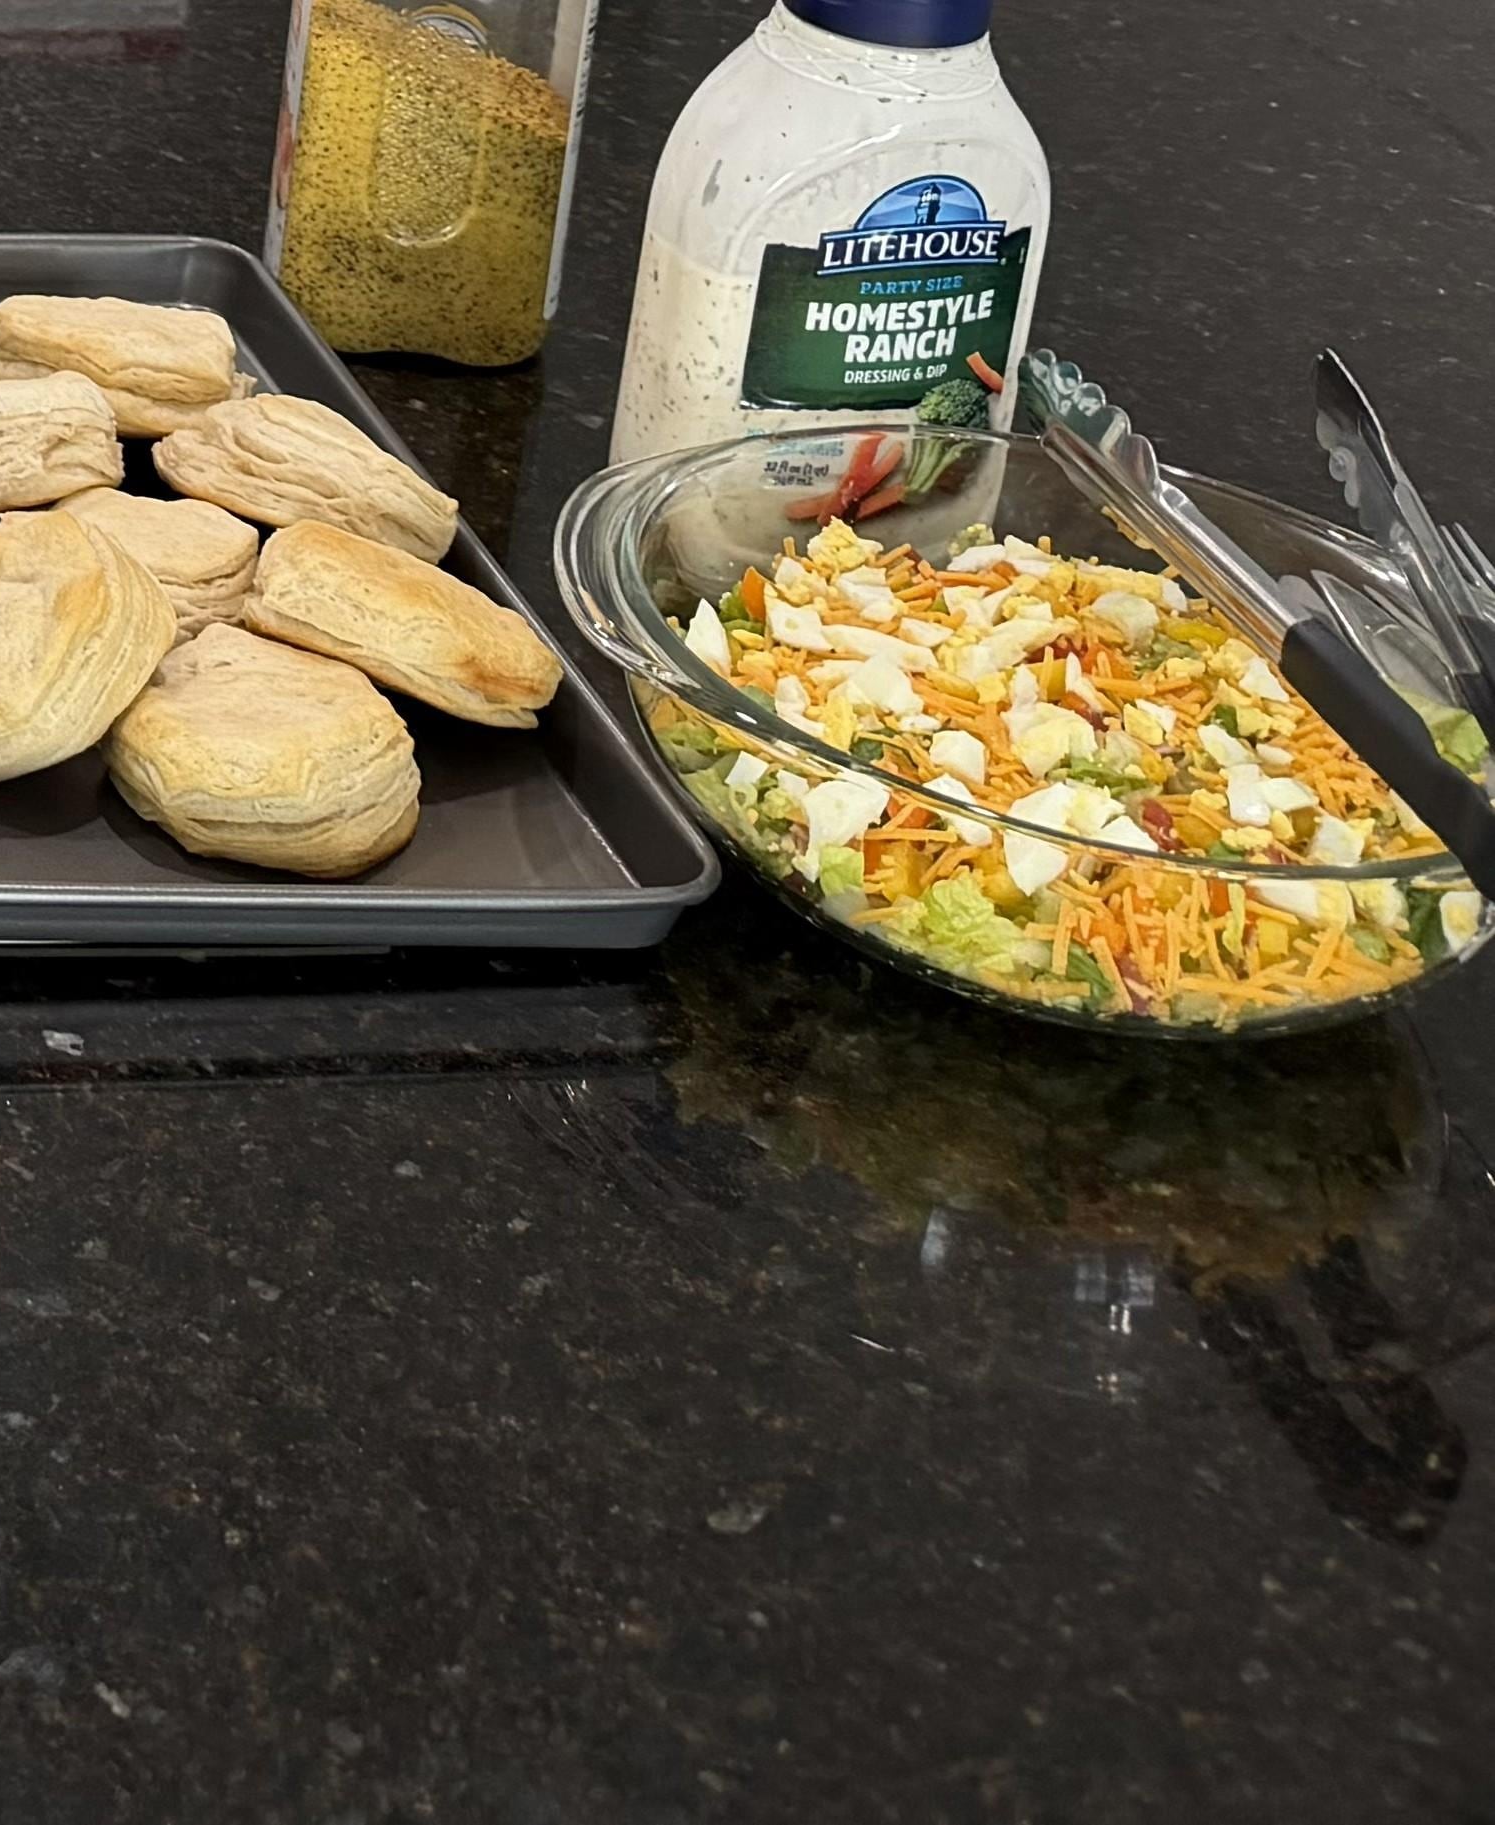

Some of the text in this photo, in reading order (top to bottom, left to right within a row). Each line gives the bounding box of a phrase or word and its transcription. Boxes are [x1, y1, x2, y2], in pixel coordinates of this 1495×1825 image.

[823, 230, 1001, 267] LITEHOUSE
[860, 275, 964, 295] PARTY SIZE
[805, 289, 995, 332] HOMESTYLE
[844, 327, 957, 363] RANCH
[844, 363, 948, 384] DRESSING & DIP
